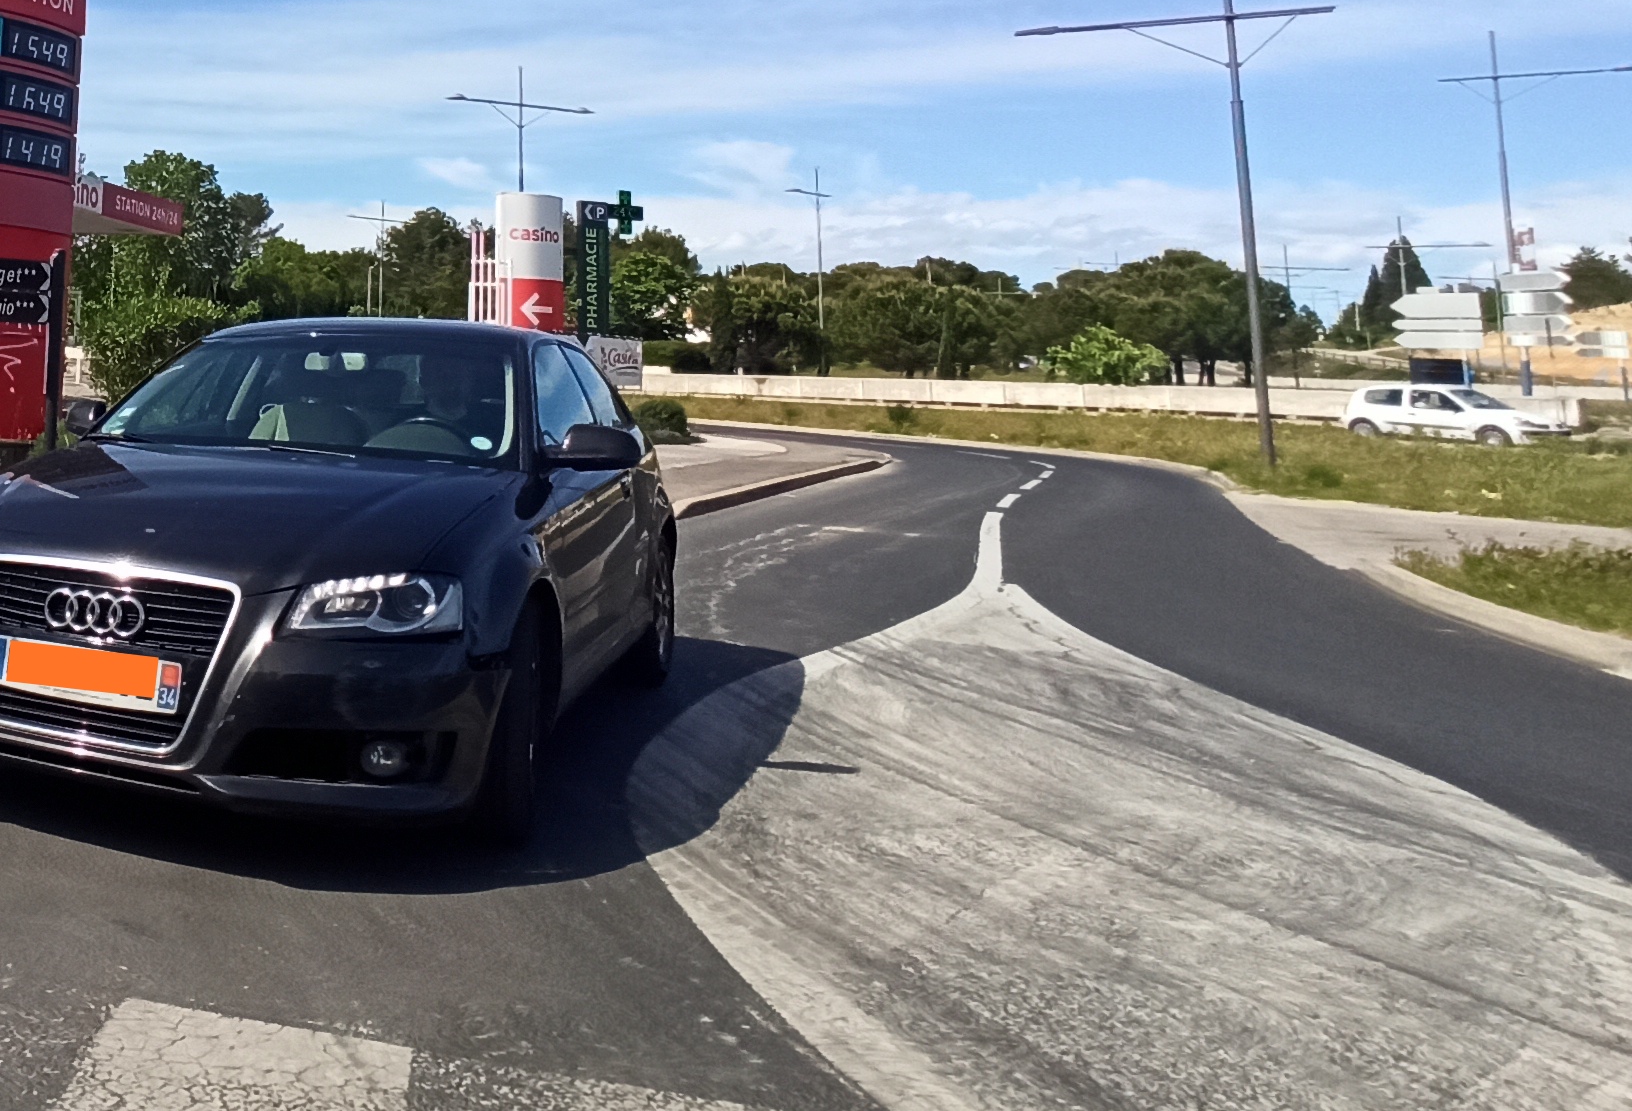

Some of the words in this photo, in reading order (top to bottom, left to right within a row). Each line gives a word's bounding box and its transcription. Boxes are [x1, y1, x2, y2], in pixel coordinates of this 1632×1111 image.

[115, 194, 150, 218] STATION
[596, 207, 605, 219] P
[509, 226, 559, 244] casino
[586, 227, 598, 329] PHARMACIE
[158, 687, 176, 706] 34
